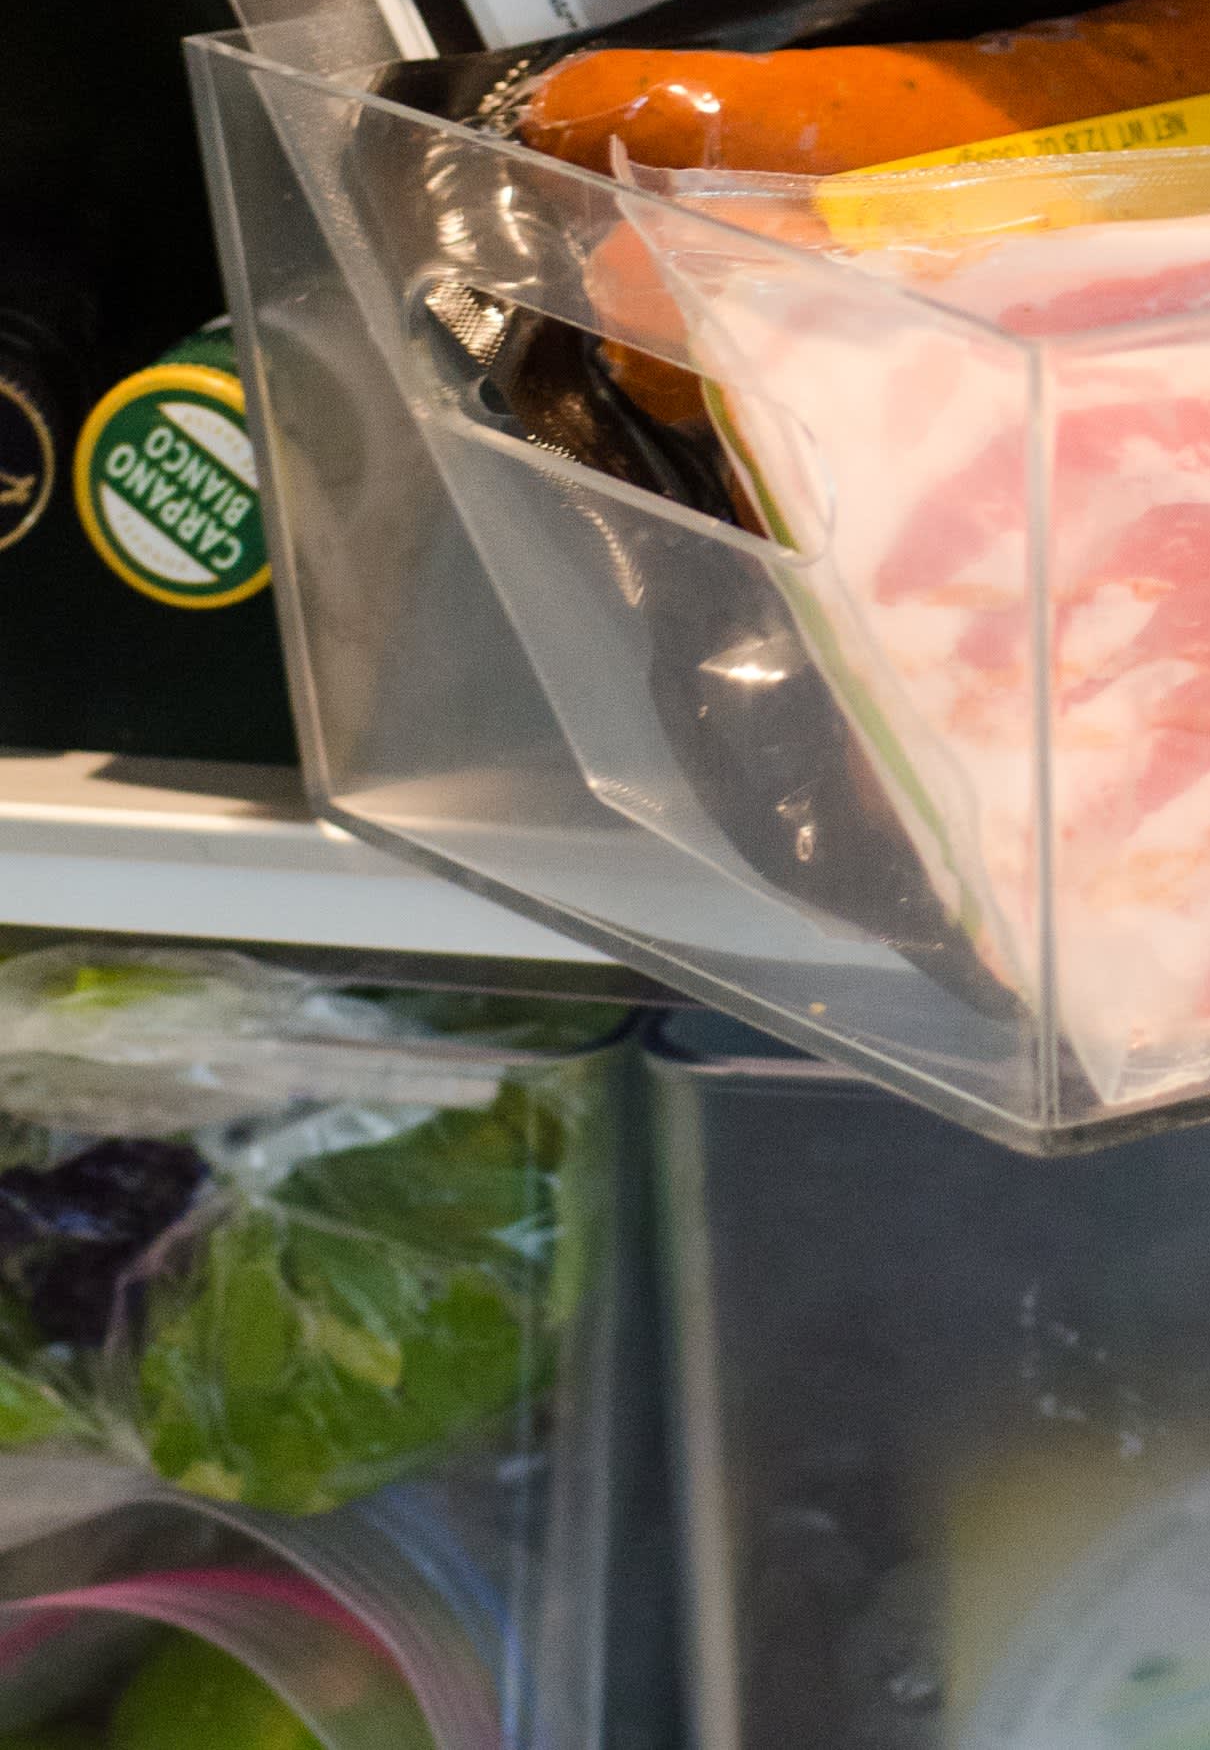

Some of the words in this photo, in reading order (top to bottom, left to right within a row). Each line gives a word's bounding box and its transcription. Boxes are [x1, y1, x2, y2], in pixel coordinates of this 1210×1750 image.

[1119, 119, 1147, 148] WT
[1153, 111, 1188, 142] NET
[105, 443, 243, 571] CARPANO
[144, 426, 251, 528] BIANCO
